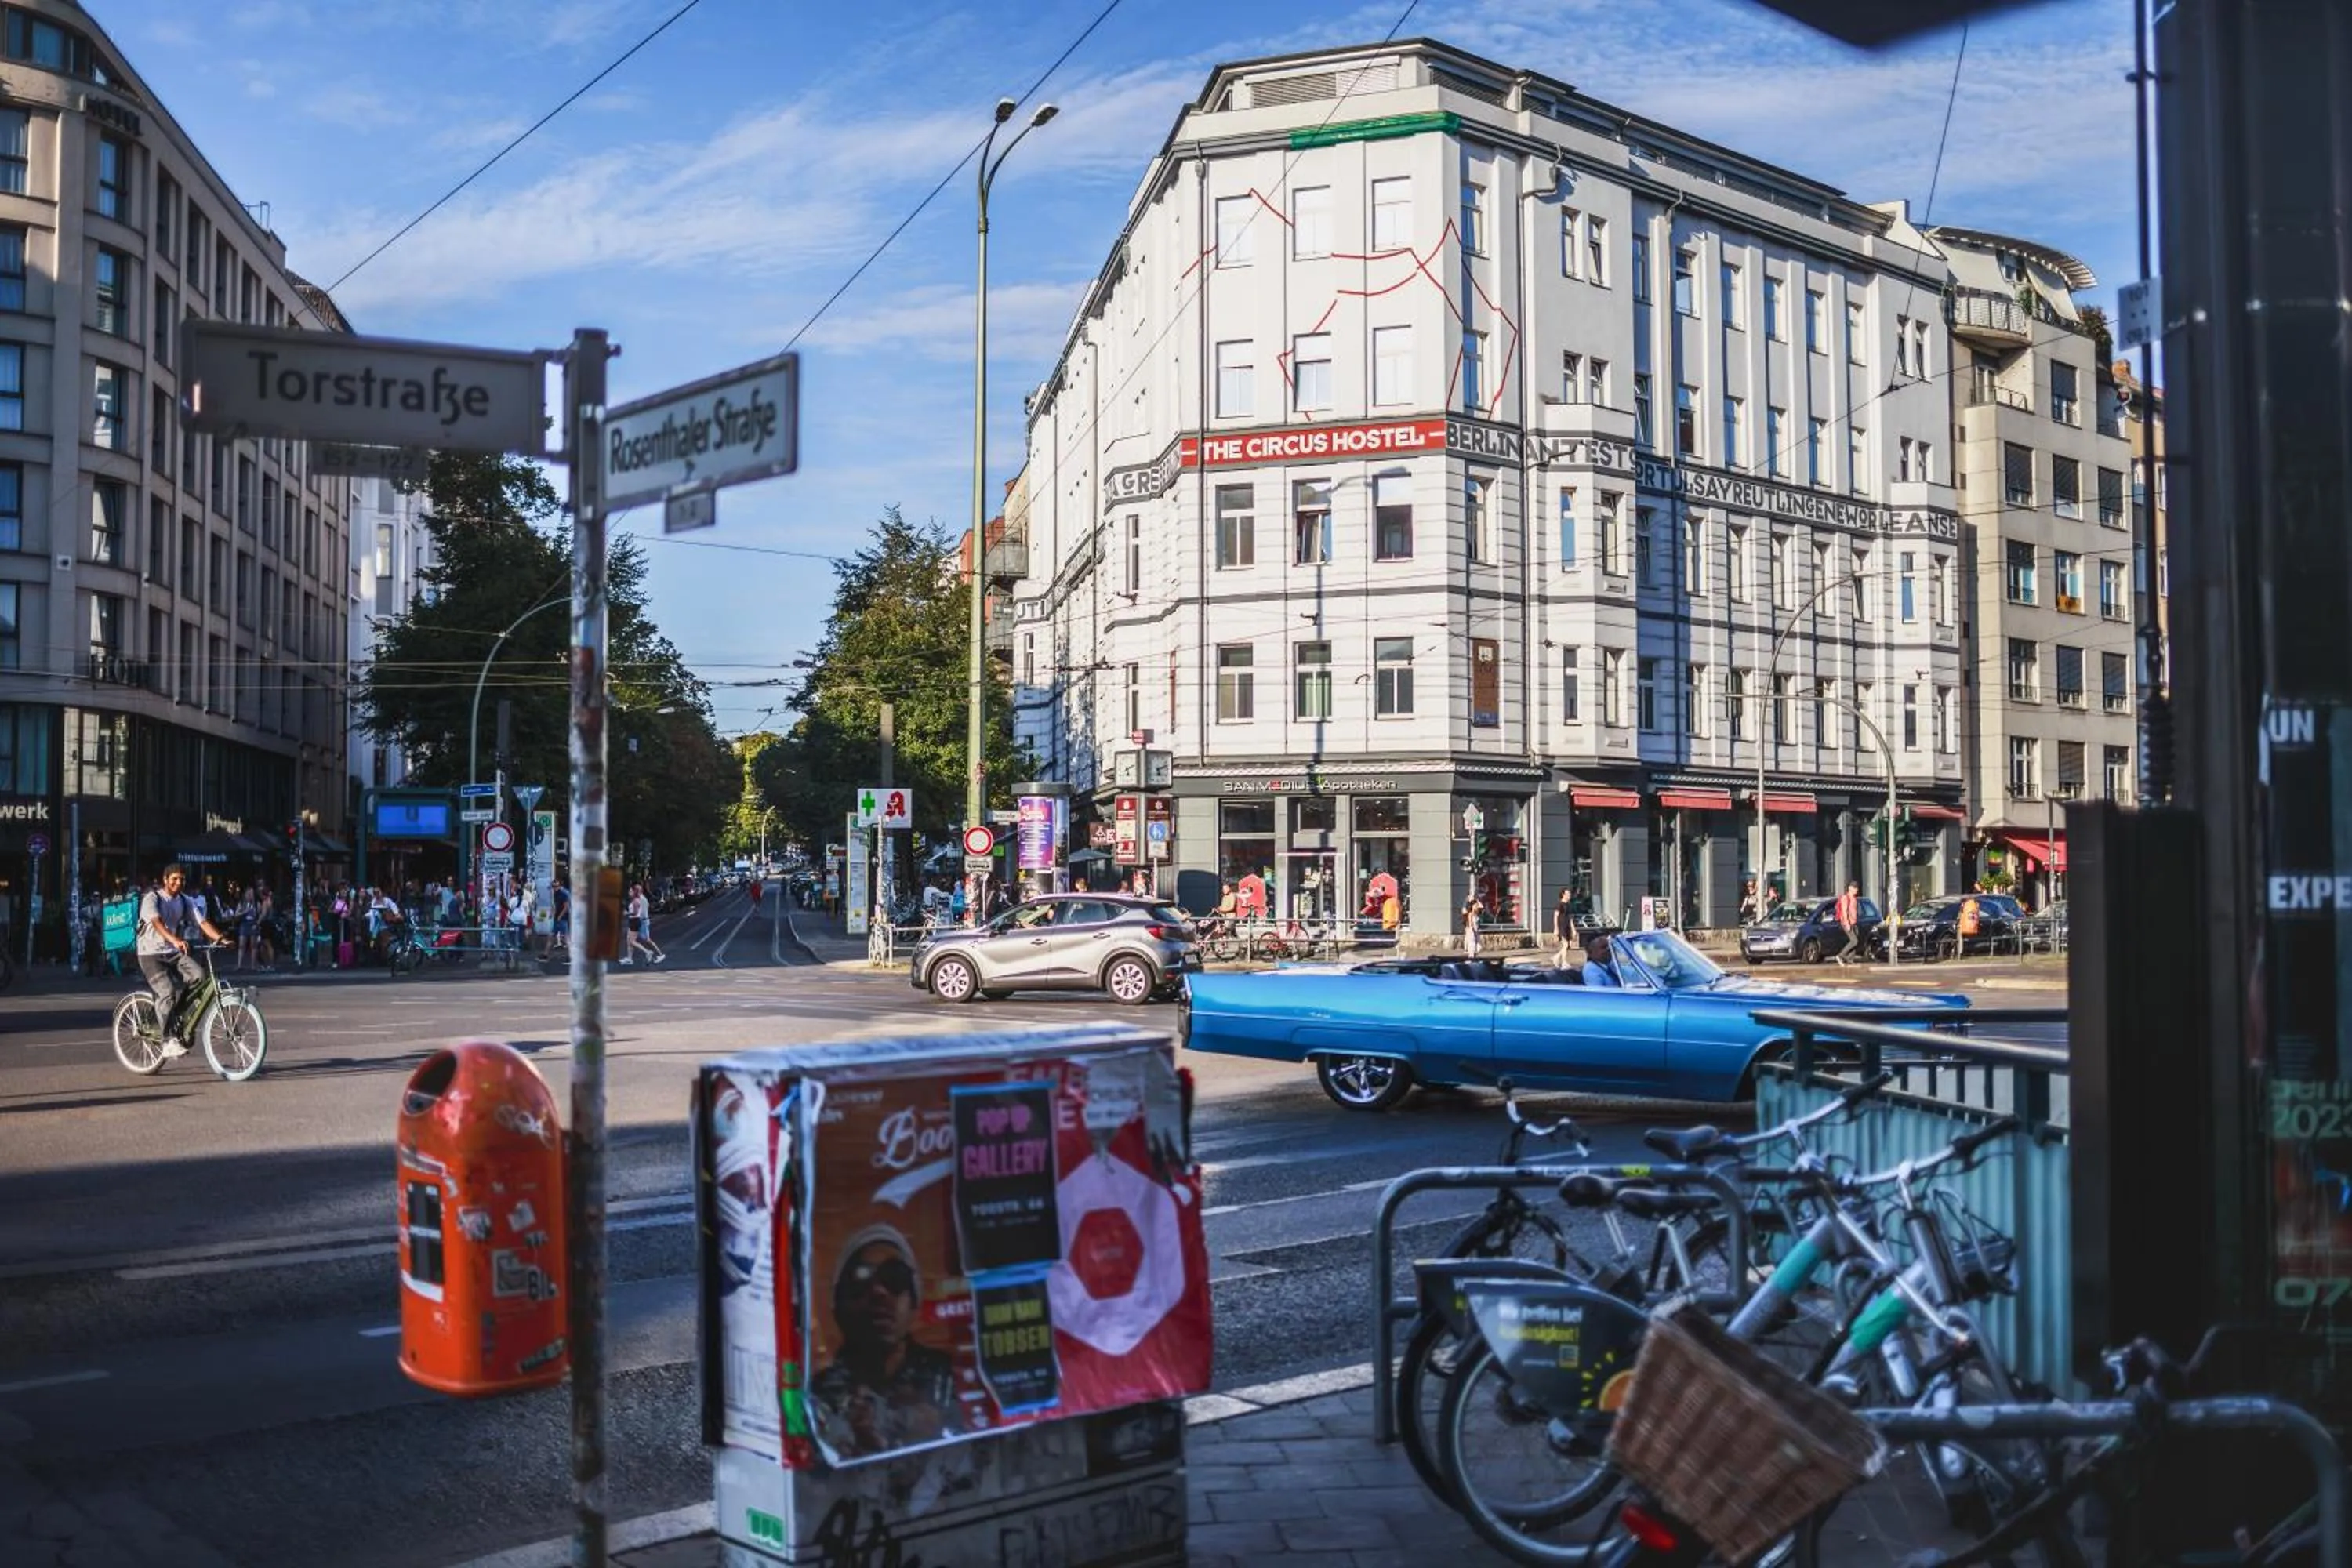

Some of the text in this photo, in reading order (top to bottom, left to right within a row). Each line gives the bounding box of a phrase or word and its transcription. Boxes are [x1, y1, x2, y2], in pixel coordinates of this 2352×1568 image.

[246, 350, 491, 426] Torstraße
[610, 387, 777, 475] Rosenthaler Straße
[1203, 425, 1425, 461] THE CIRCUS HOSTEL
[1223, 779, 1312, 792] SANIMEDIU
[0, 801, 49, 820] werk
[963, 1138, 1048, 1180] GALLERY
